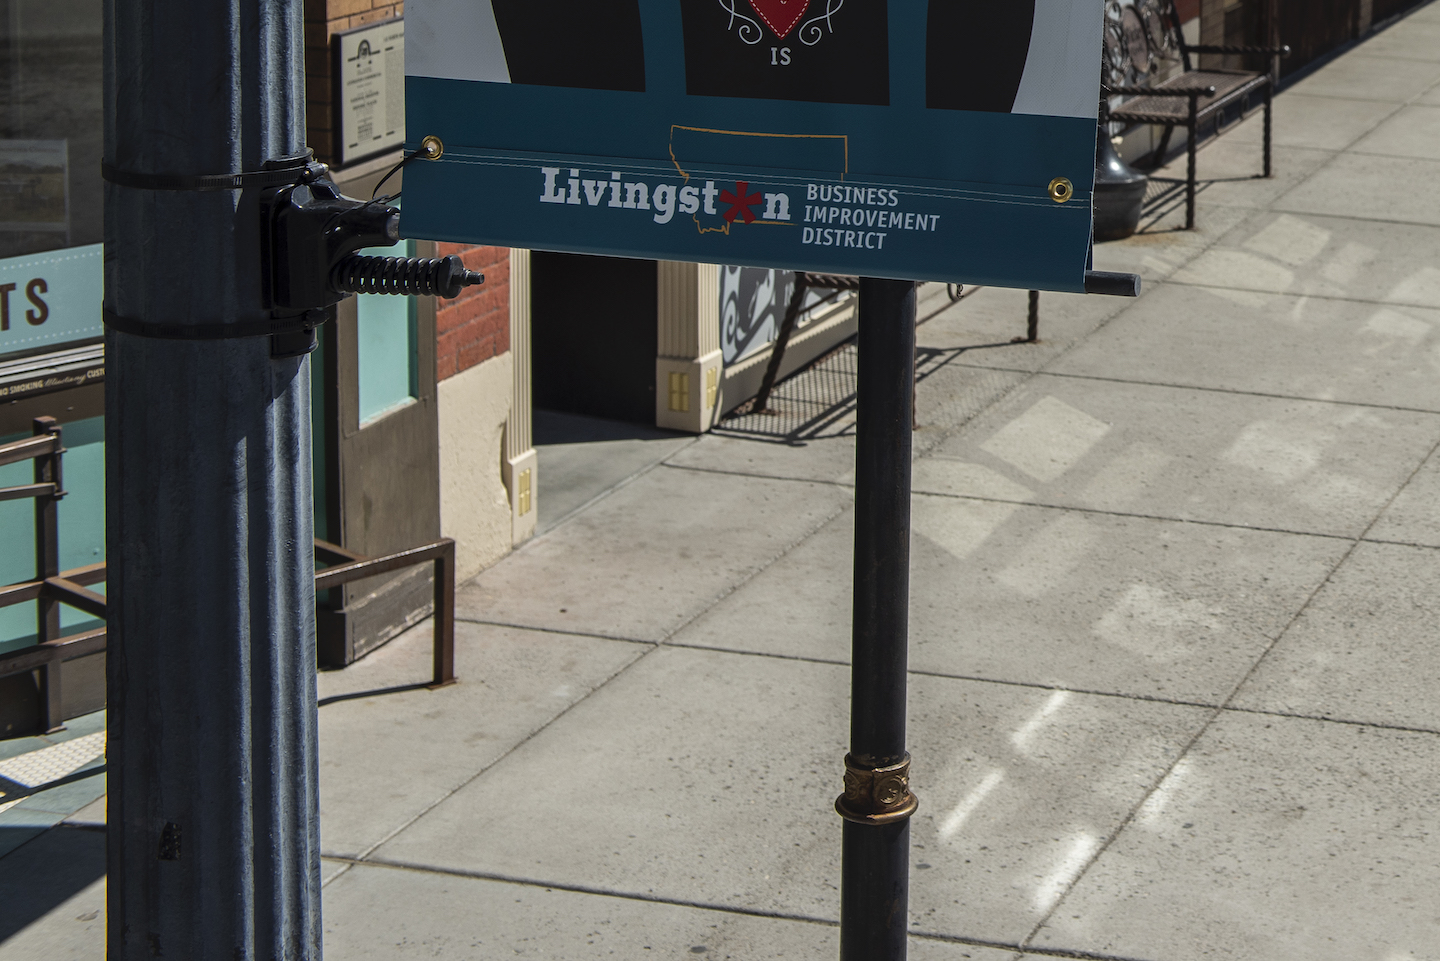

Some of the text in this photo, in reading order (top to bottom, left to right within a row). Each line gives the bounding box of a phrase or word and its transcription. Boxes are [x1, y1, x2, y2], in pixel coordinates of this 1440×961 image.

[770, 46, 792, 66] IS
[806, 183, 900, 207] BUSINESS
[803, 205, 941, 233] IMPROVEMENT
[801, 226, 888, 250] DISTRICT
[9, 379, 44, 396] SMOKING
